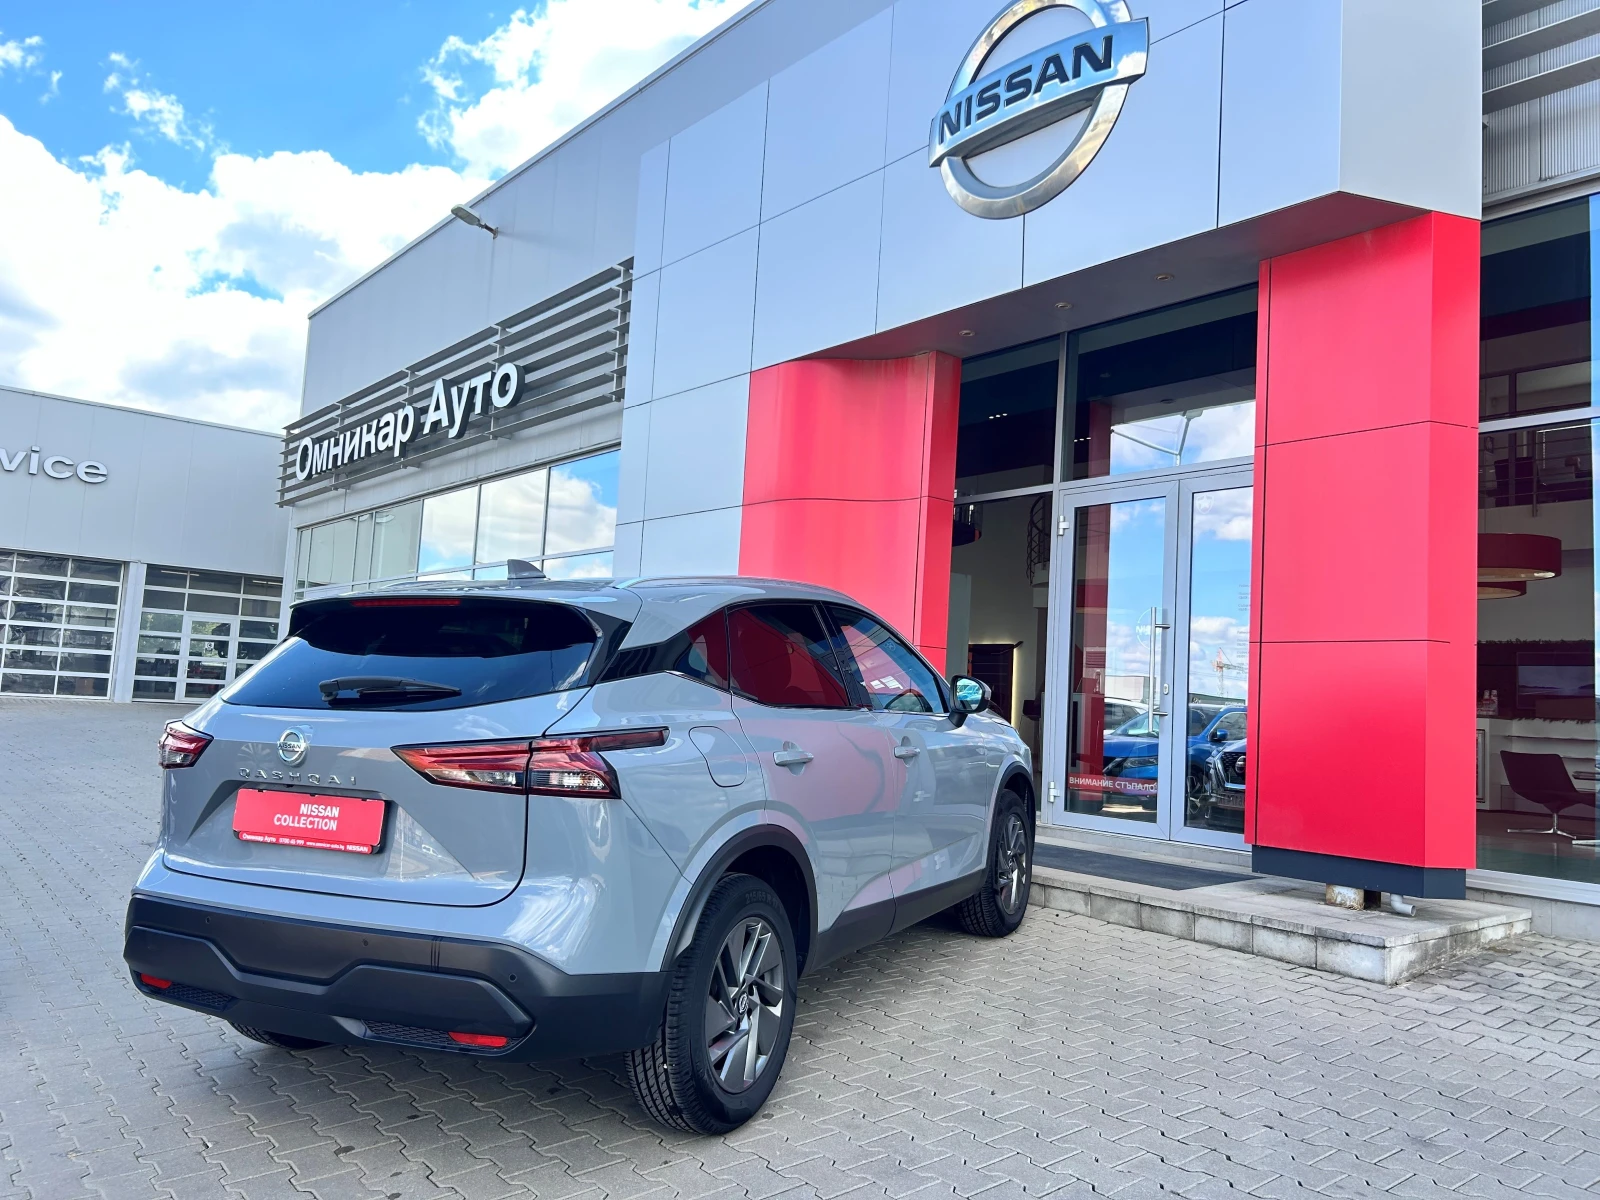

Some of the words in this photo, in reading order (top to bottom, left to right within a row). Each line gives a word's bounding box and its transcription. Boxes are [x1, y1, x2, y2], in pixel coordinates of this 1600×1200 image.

[938, 34, 1113, 145] NISSAN
[295, 406, 418, 480] Омникар
[422, 362, 521, 438] Ауто
[278, 742, 302, 750] NISSAN
[239, 768, 356, 785] QASHQAI
[1069, 776, 1114, 788] ВНИМАНИЕ
[299, 803, 340, 818] NISSAN
[273, 813, 338, 831] COLLECTION
[346, 845, 369, 853] NISSAN
